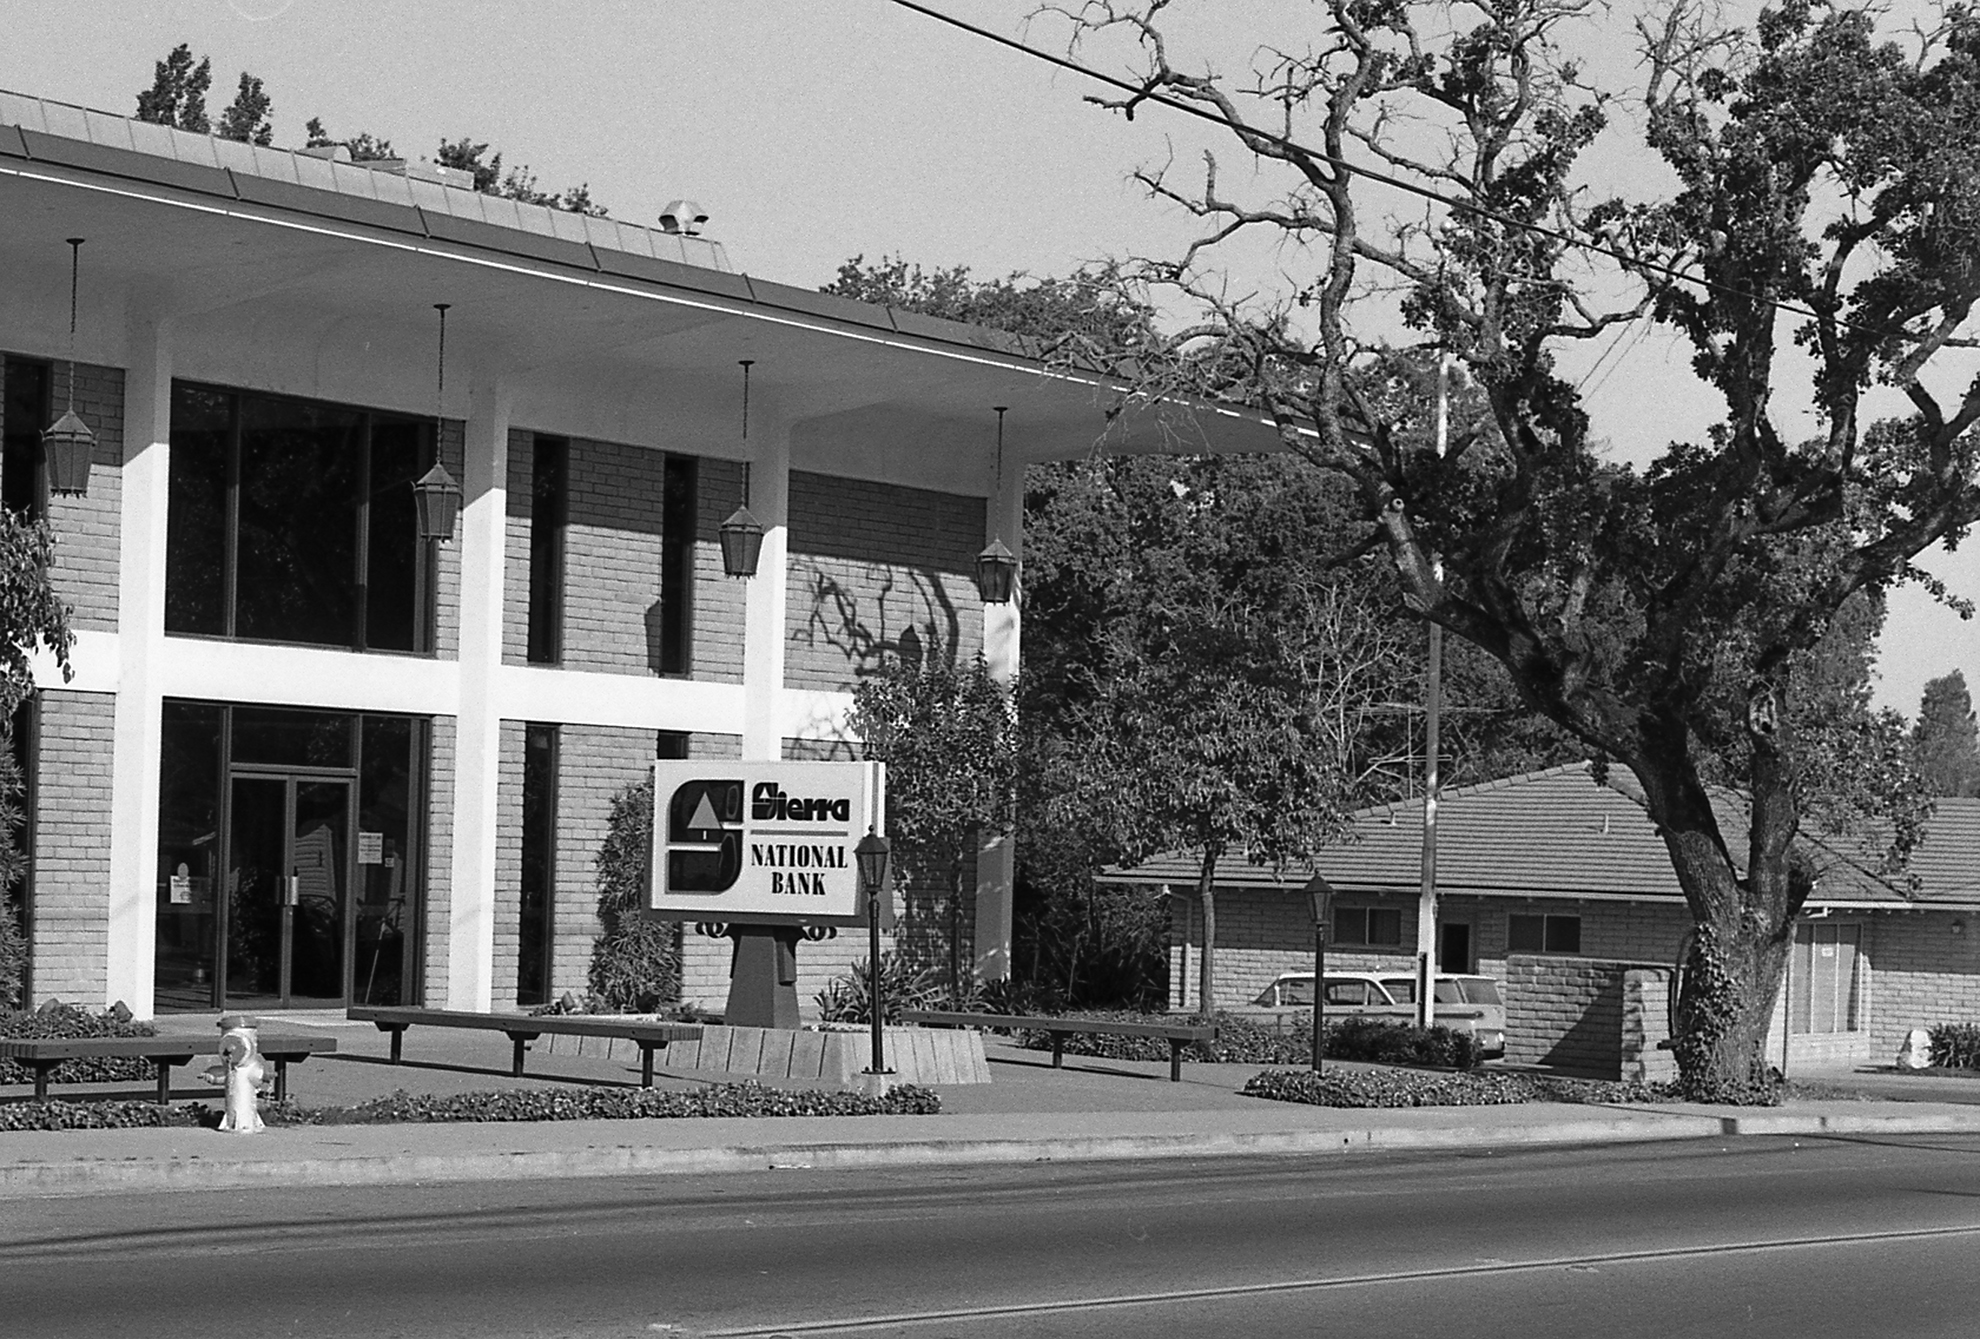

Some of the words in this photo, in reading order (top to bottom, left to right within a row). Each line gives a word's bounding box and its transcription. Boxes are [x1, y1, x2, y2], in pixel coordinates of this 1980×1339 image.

[752, 782, 850, 822] Sierra
[751, 844, 849, 868] NATIONAL
[771, 872, 826, 895] BANK
